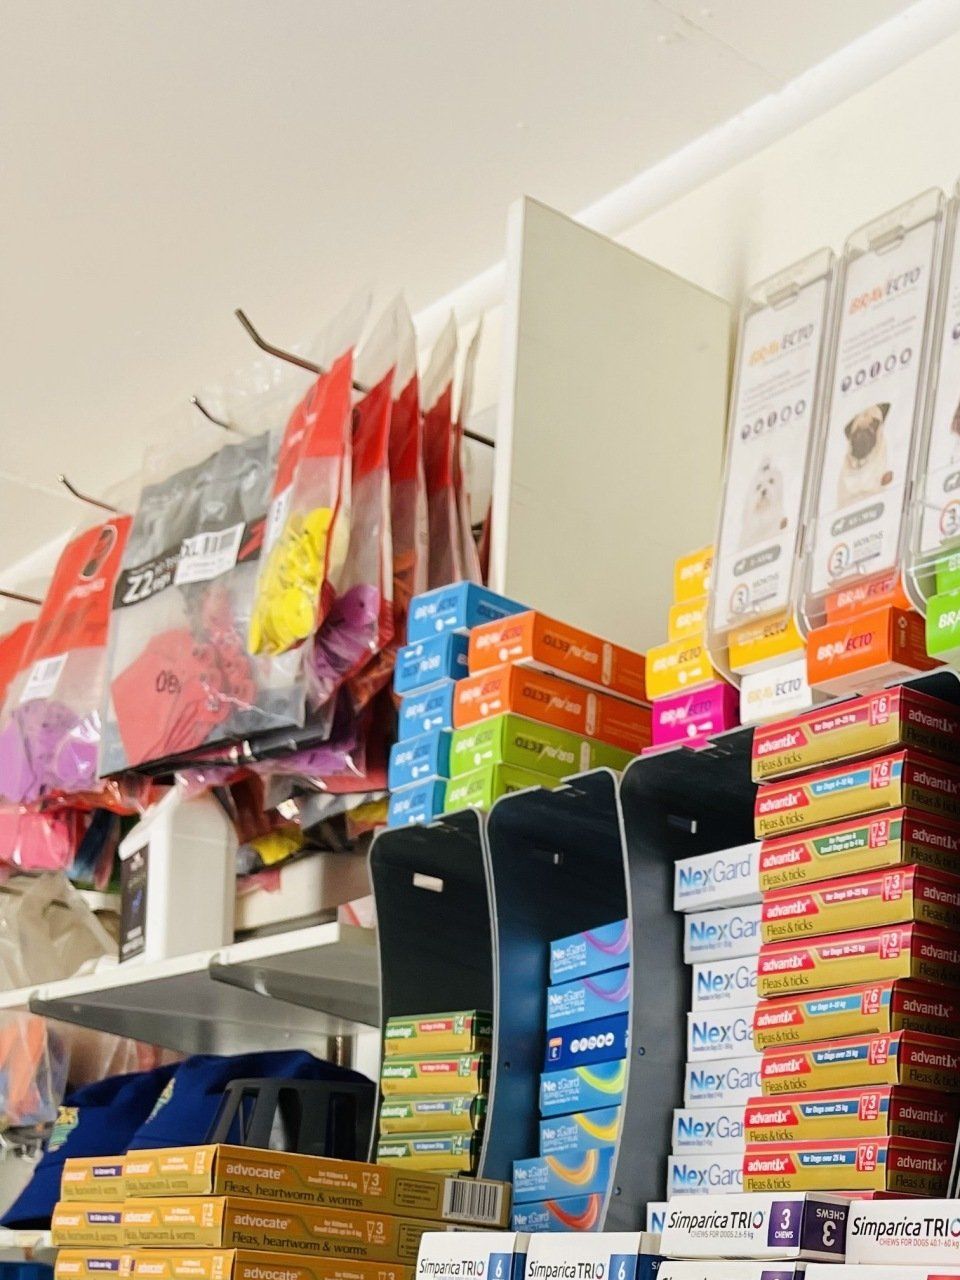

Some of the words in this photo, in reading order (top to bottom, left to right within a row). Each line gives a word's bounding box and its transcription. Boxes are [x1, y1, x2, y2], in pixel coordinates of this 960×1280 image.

[849, 266, 921, 315] BRAVECTO
[679, 856, 750, 888] NexGard
[911, 1051, 957, 1068] advantix
[766, 1081, 786, 1092] Fleas
[787, 1082, 792, 1090] &
[793, 1080, 807, 1090] ticks
[226, 1162, 281, 1180] advocate
[897, 1157, 942, 1172] advantix
[667, 1211, 728, 1235] Simparica
[730, 1211, 764, 1230] TRIO
[781, 1210, 790, 1230] 3
[816, 1209, 846, 1220] CHEWS
[774, 1231, 793, 1239] CHEWS
[461, 1261, 485, 1276] TRIO
[495, 1259, 503, 1277] 6
